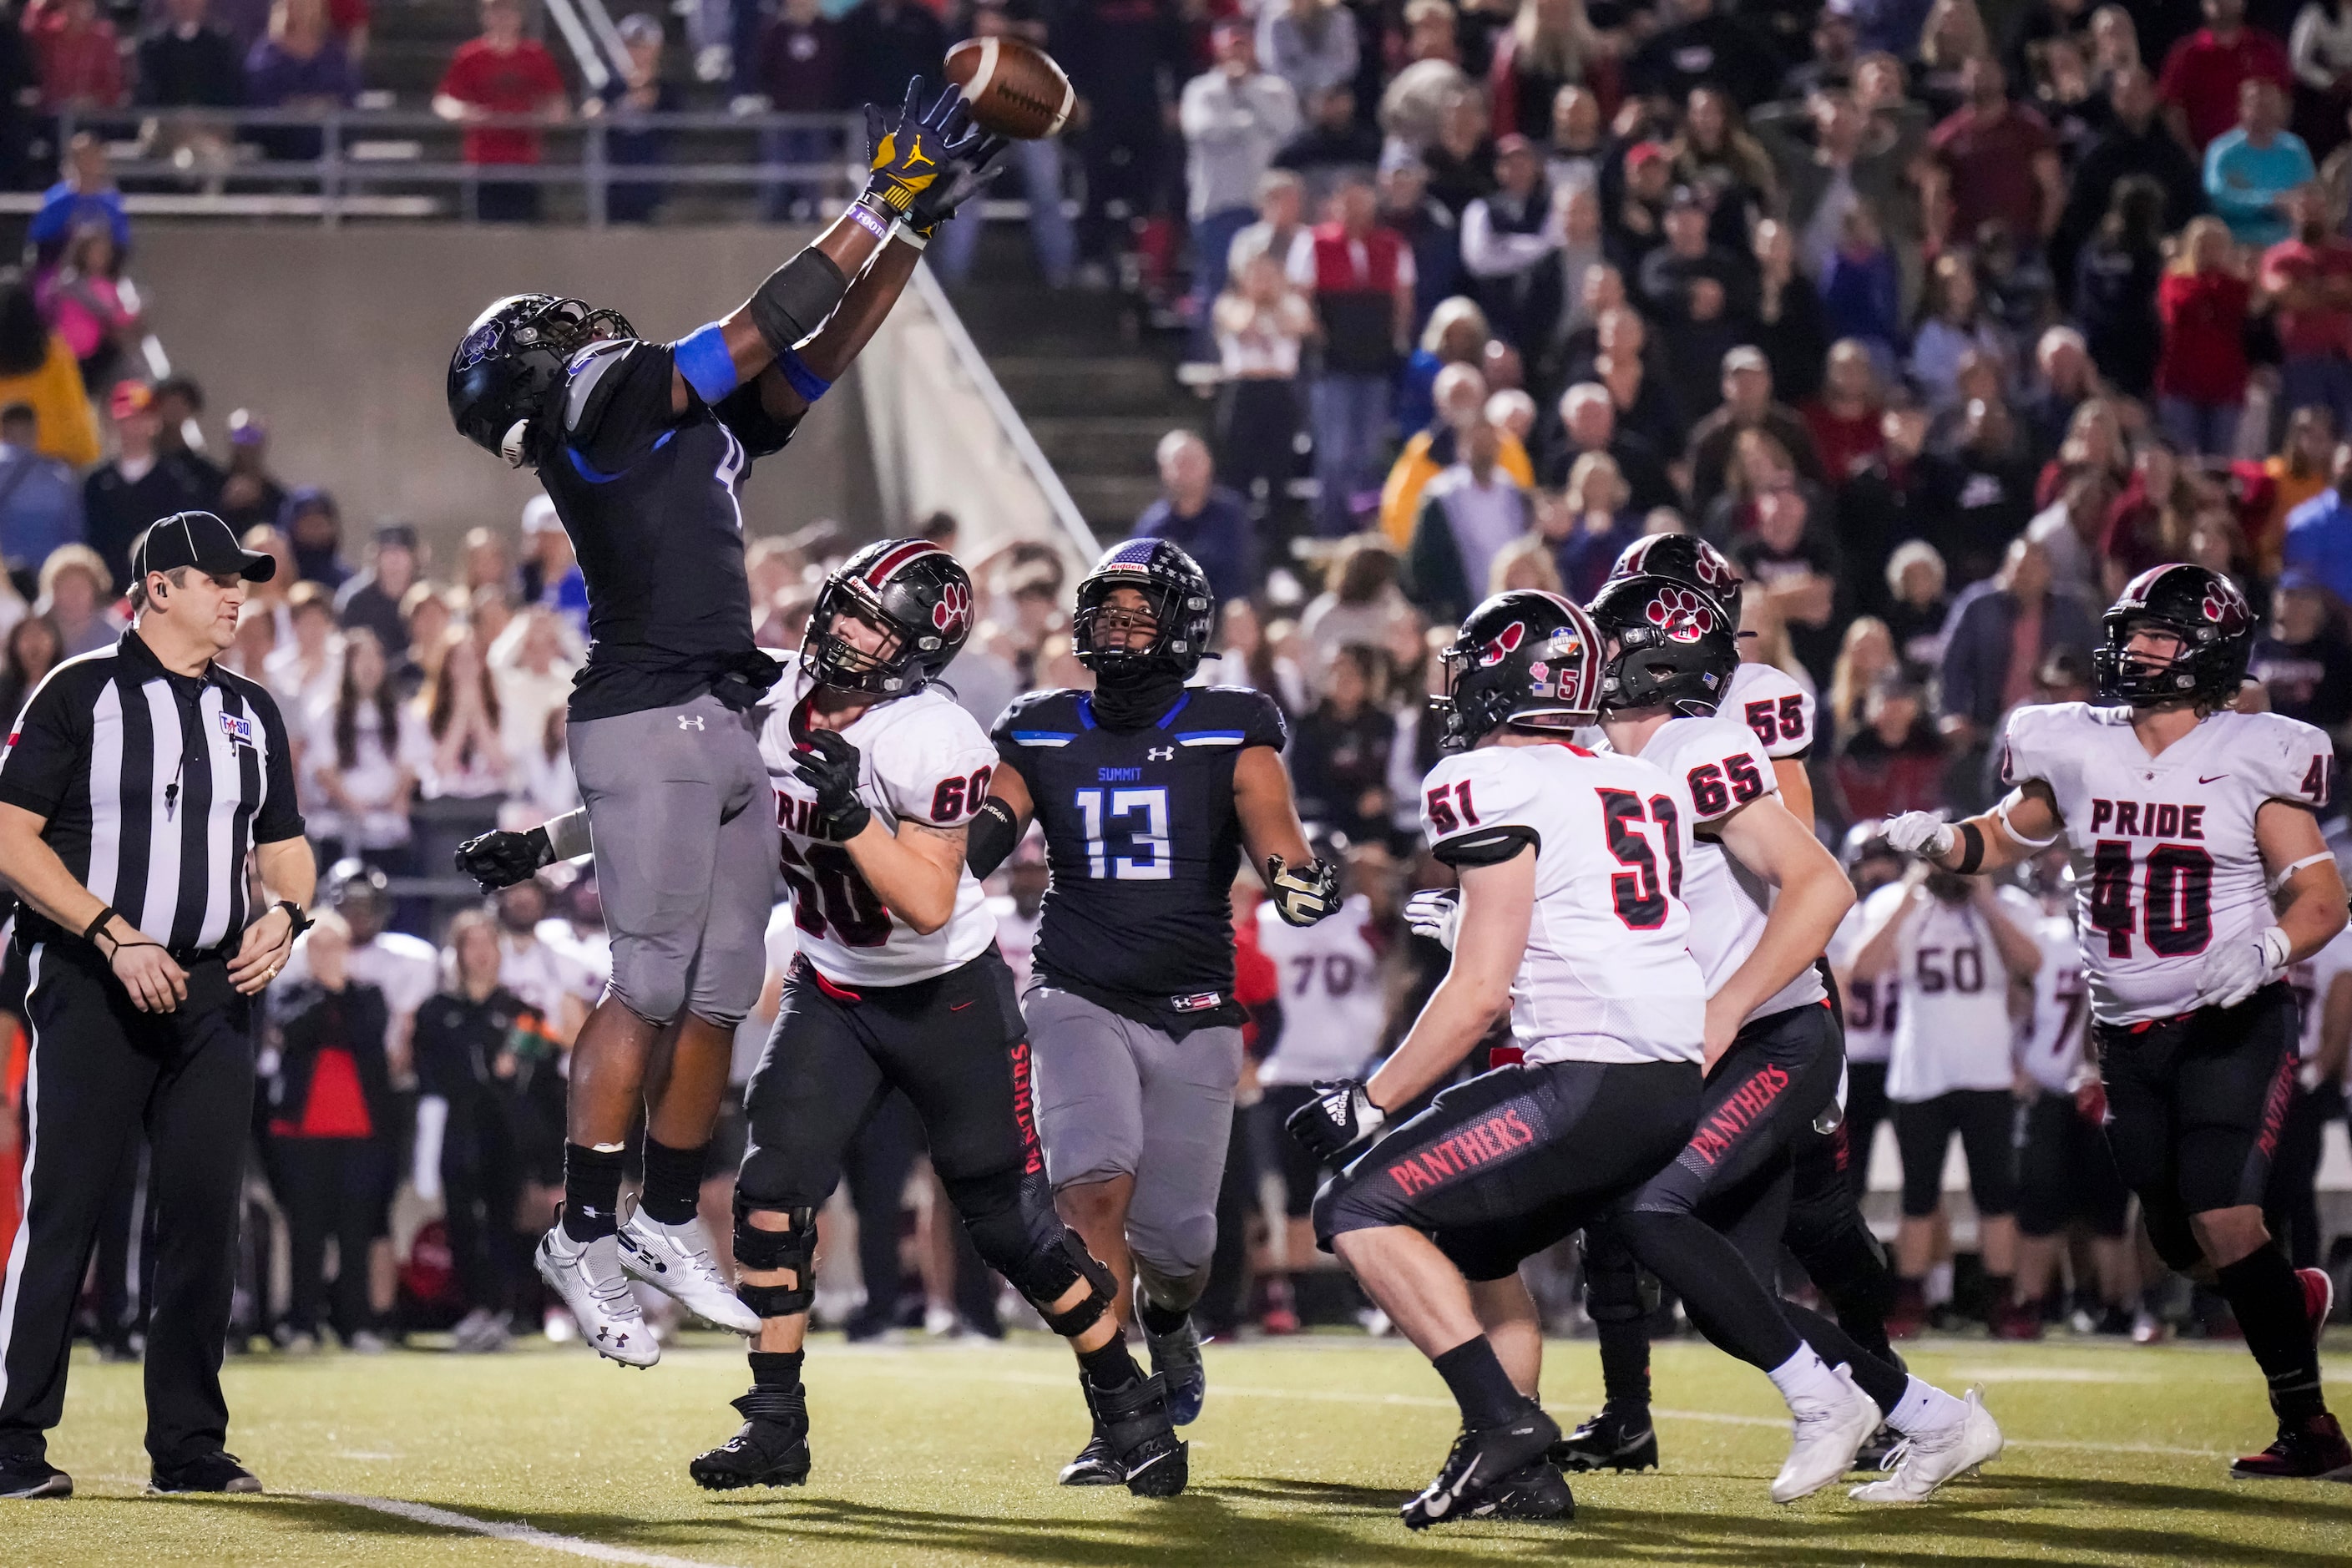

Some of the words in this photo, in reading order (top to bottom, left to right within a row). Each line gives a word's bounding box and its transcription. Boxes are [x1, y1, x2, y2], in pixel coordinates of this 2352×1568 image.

[1745, 693, 1805, 747] 55
[931, 765, 992, 823] 60
[1098, 767, 1142, 781] SUMMIT
[1687, 752, 1764, 817] 65
[1075, 786, 1173, 880] 13
[1428, 779, 1480, 837] 51
[2090, 798, 2206, 840] PRIDE
[1594, 787, 1683, 930] 51
[2091, 839, 2216, 959] 40
[1290, 953, 1356, 998] 70
[1916, 947, 1983, 994] 50
[1011, 1043, 1042, 1176] PANTHERS
[1337, 1090, 1351, 1127] adidas
[1688, 1063, 1789, 1166] PANTHERS
[1388, 1109, 1534, 1197] PANTHERS
